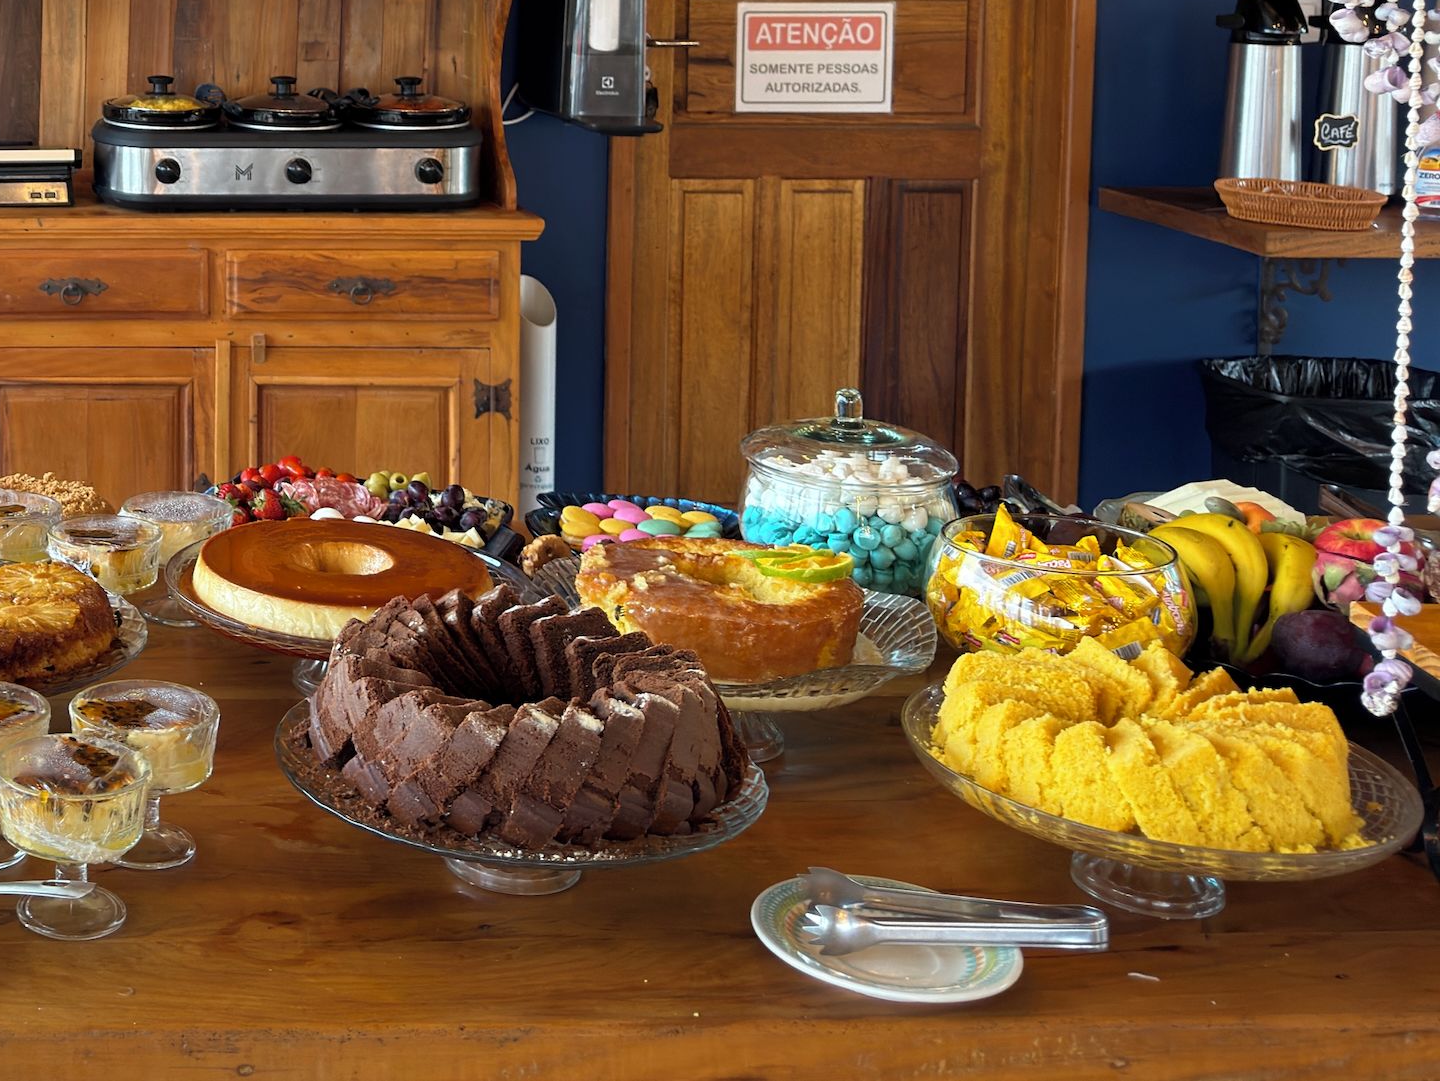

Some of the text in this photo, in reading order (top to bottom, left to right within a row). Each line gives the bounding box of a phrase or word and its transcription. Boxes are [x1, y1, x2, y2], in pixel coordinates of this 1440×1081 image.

[755, 18, 874, 49] ATENÇÃO
[749, 63, 878, 74] SOMENTE PESSOAS
[764, 82, 862, 93] AUTORIZADAS.
[530, 437, 550, 446] LIXO
